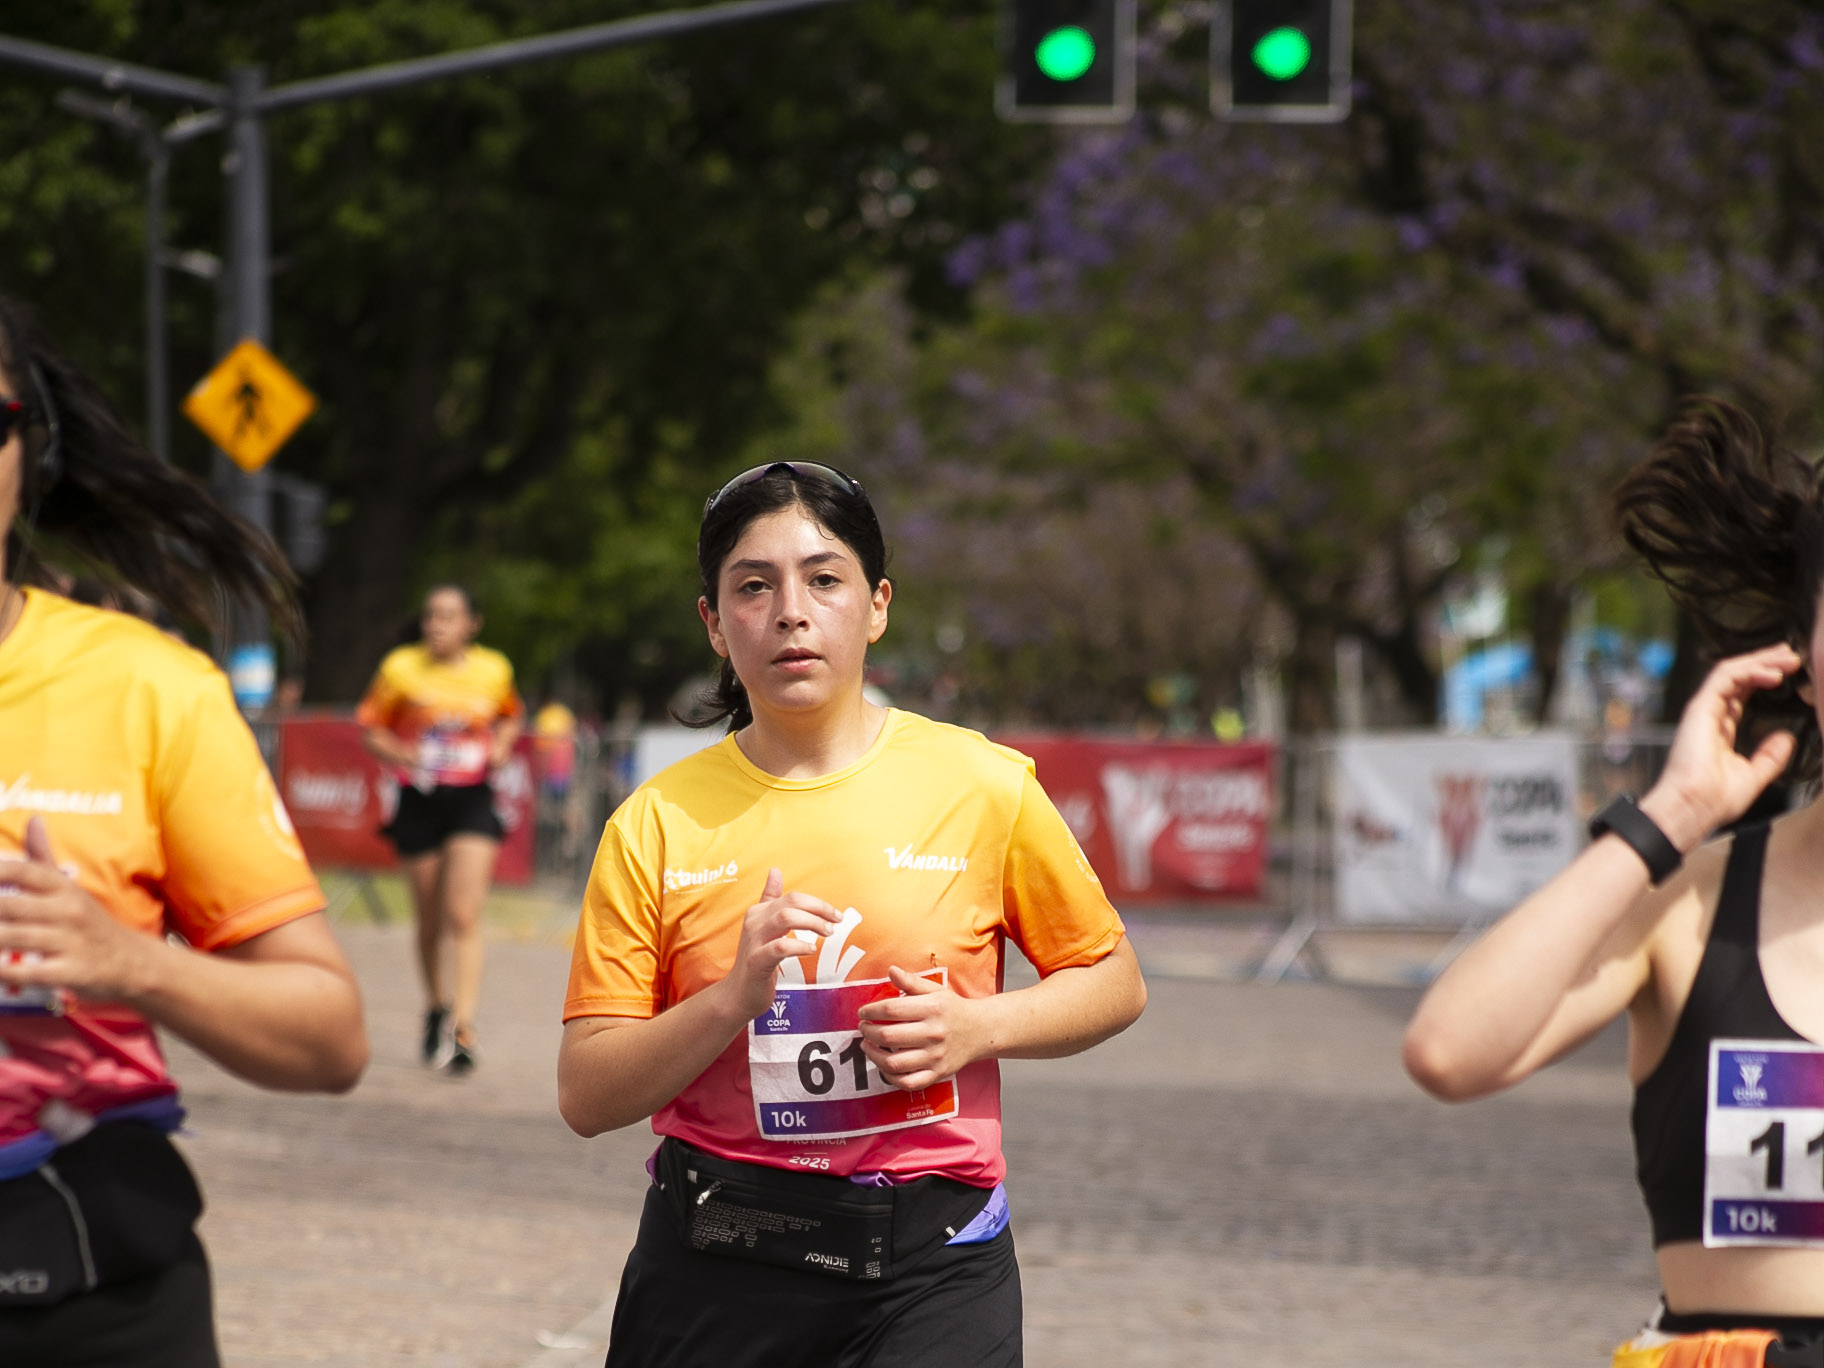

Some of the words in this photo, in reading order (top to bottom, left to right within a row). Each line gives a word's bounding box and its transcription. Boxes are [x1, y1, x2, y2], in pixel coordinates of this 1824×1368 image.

[725, 860, 738, 876] 6
[767, 1019, 791, 1027] COPA
[798, 1037, 892, 1096] 61
[771, 1111, 807, 1128] 10k
[906, 1110, 925, 1119] Santa
[926, 1108, 934, 1116] Fe
[789, 1156, 830, 1170] 2025
[1725, 1206, 1778, 1232] 10k
